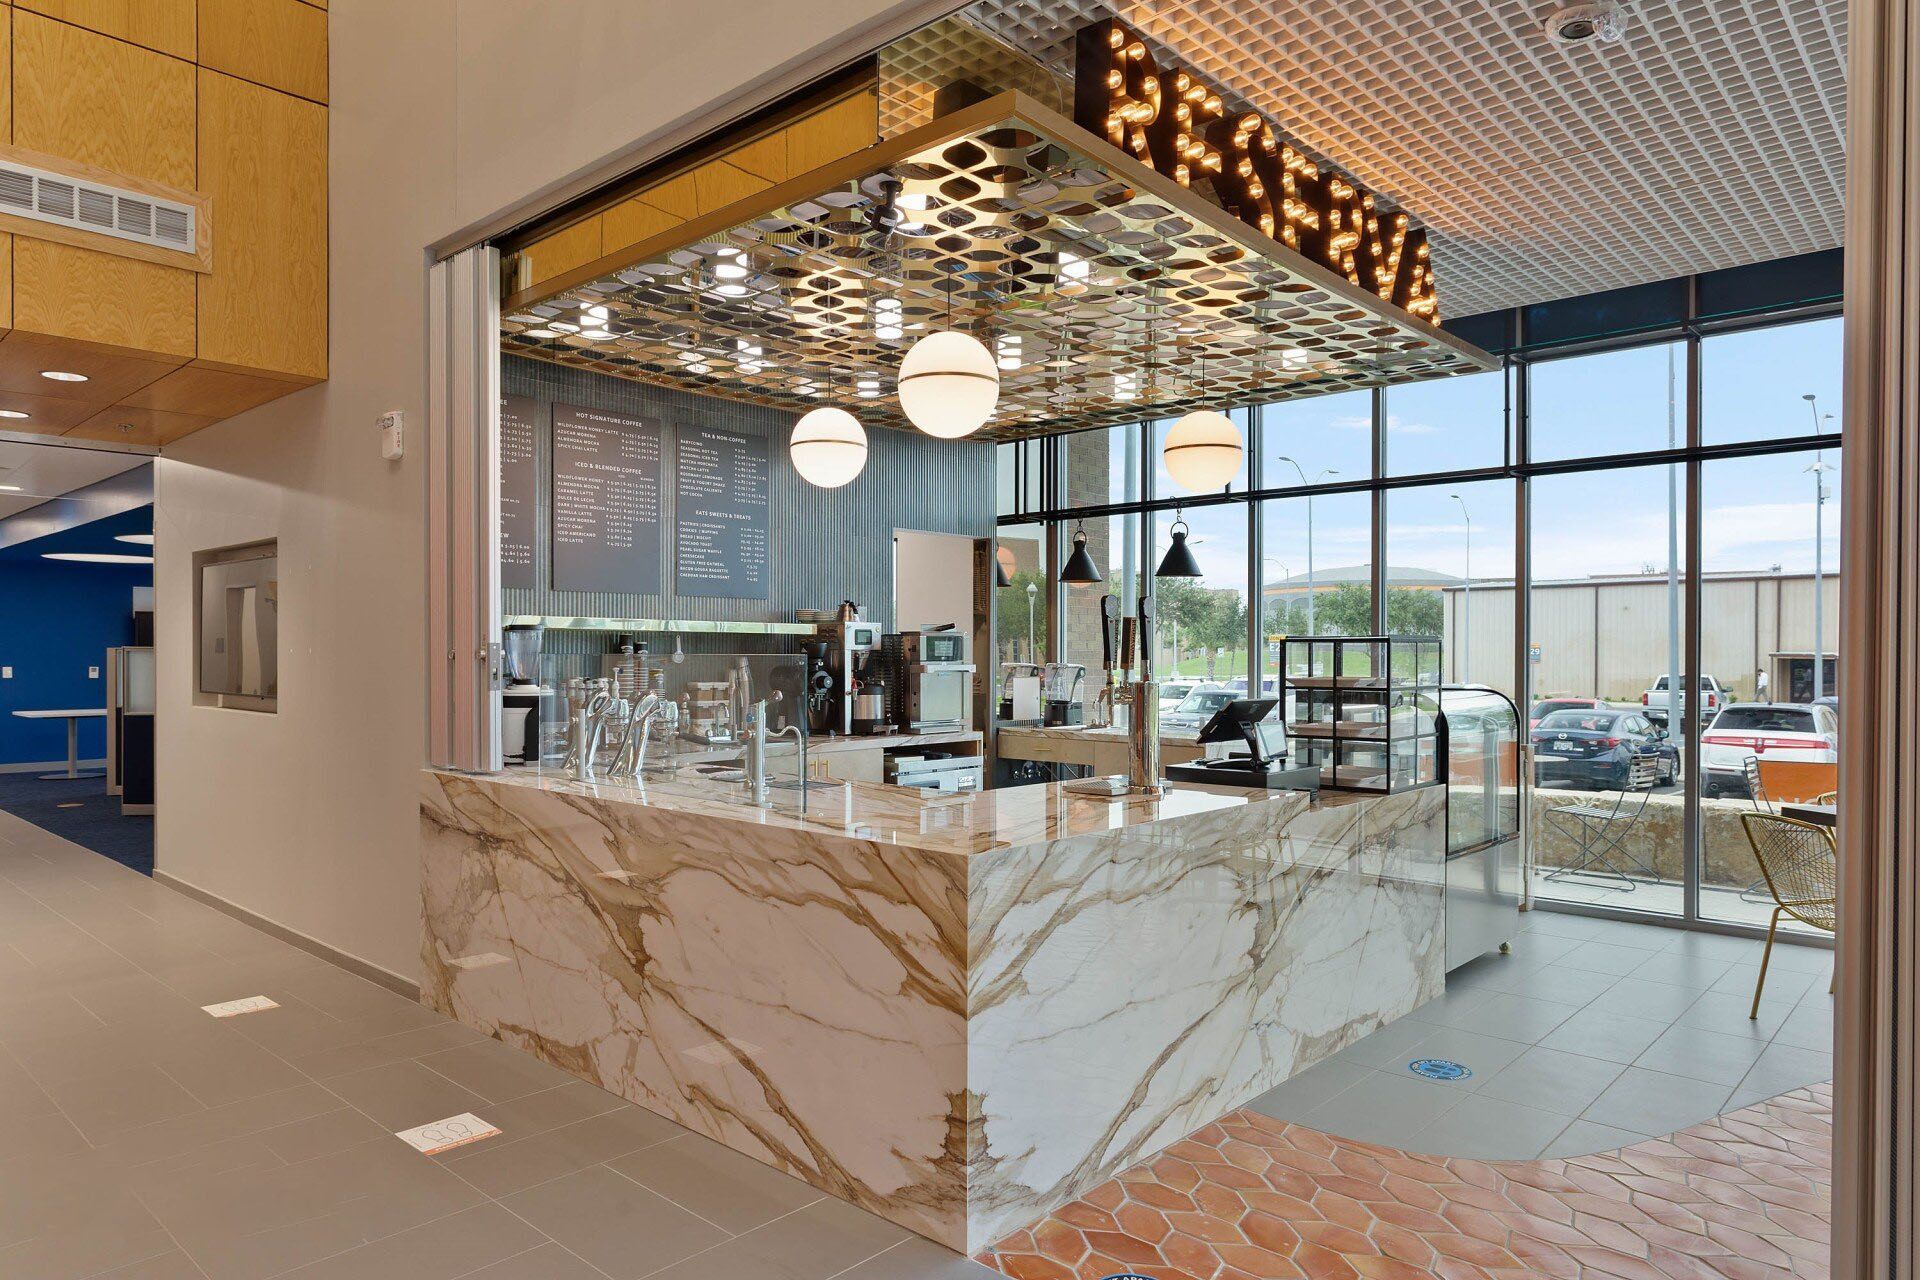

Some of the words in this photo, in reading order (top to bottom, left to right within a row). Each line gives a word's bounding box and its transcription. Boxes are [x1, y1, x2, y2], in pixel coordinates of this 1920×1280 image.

[1076, 17, 1440, 327] RESERVA
[590, 414, 620, 424] SIGNATURE
[557, 422, 588, 430] WILDFLOWER
[717, 435, 746, 444] NON-COFFEE
[595, 464, 620, 472] BLENDED
